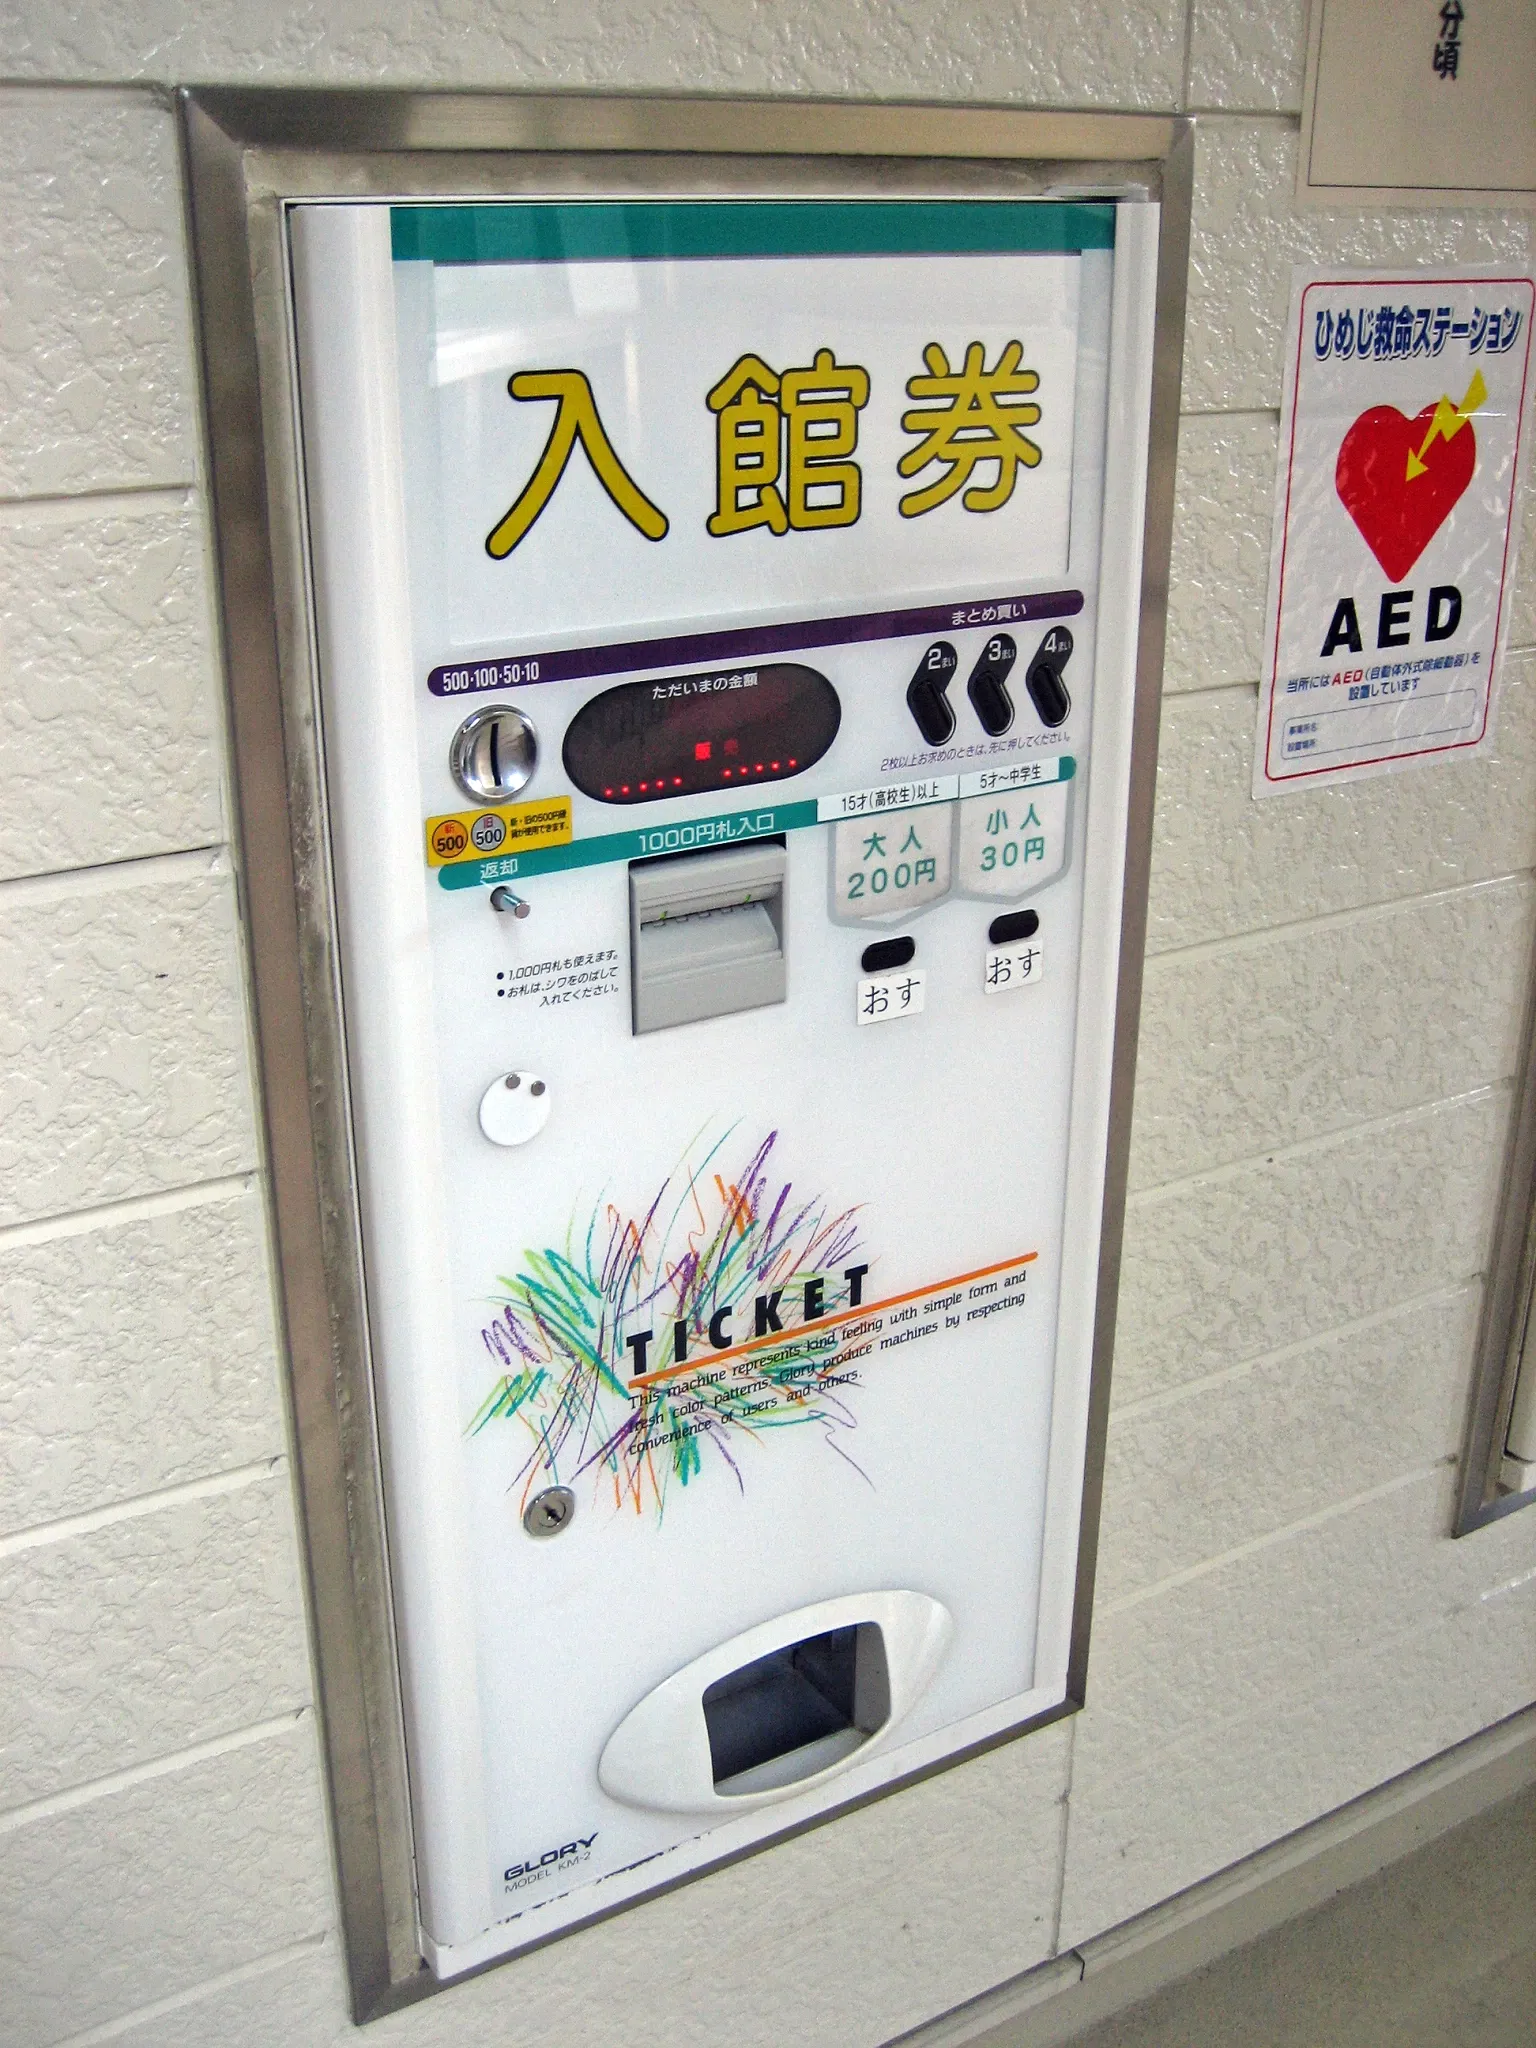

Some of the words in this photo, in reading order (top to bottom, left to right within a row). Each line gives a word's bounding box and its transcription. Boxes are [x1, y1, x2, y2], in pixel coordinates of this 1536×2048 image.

[1315, 304, 1522, 361] ひめじ救命ステーション
[485, 339, 1043, 560] 入館券
[951, 603, 1027, 626] まとめ買い
[1319, 584, 1463, 657] AED
[652, 672, 758, 700] ただいまの金額
[1348, 677, 1420, 701] 設置しています
[475, 828, 502, 844] 500
[483, 817, 493, 829] 旧
[638, 813, 775, 852] 1000円札入口
[986, 803, 1041, 836] 小人
[437, 835, 464, 852] 500
[862, 825, 923, 861] 大人
[980, 836, 1045, 872] 30円
[480, 858, 519, 880] 返却
[847, 857, 937, 900] 200円
[987, 948, 1042, 986] おす
[862, 977, 921, 1016] おす
[626, 1264, 868, 1376] TICKET
[629, 1390, 660, 1410] This
[667, 1369, 727, 1397] machine
[732, 1344, 800, 1376] represents
[807, 1332, 836, 1354] kind
[842, 1318, 883, 1341] feeling
[890, 1306, 918, 1325] with
[924, 1291, 962, 1314] simple
[968, 1282, 998, 1300] form
[1004, 1270, 1027, 1288] and
[630, 1412, 665, 1434] fresh
[673, 1399, 706, 1419] color
[714, 1379, 772, 1405] patterns.
[779, 1363, 815, 1384] Glory
[823, 1342, 873, 1371] produce
[880, 1321, 939, 1350] machines
[945, 1313, 960, 1329] by
[966, 1292, 1025, 1322] respecting
[629, 1420, 712, 1456] convenience
[721, 1409, 736, 1425] of
[743, 1397, 778, 1417] users
[786, 1384, 810, 1402] and
[818, 1369, 863, 1392] others.
[504, 1831, 599, 1881] GLORY
[504, 1869, 552, 1894] MODEL
[558, 1851, 591, 1872] KM-2
